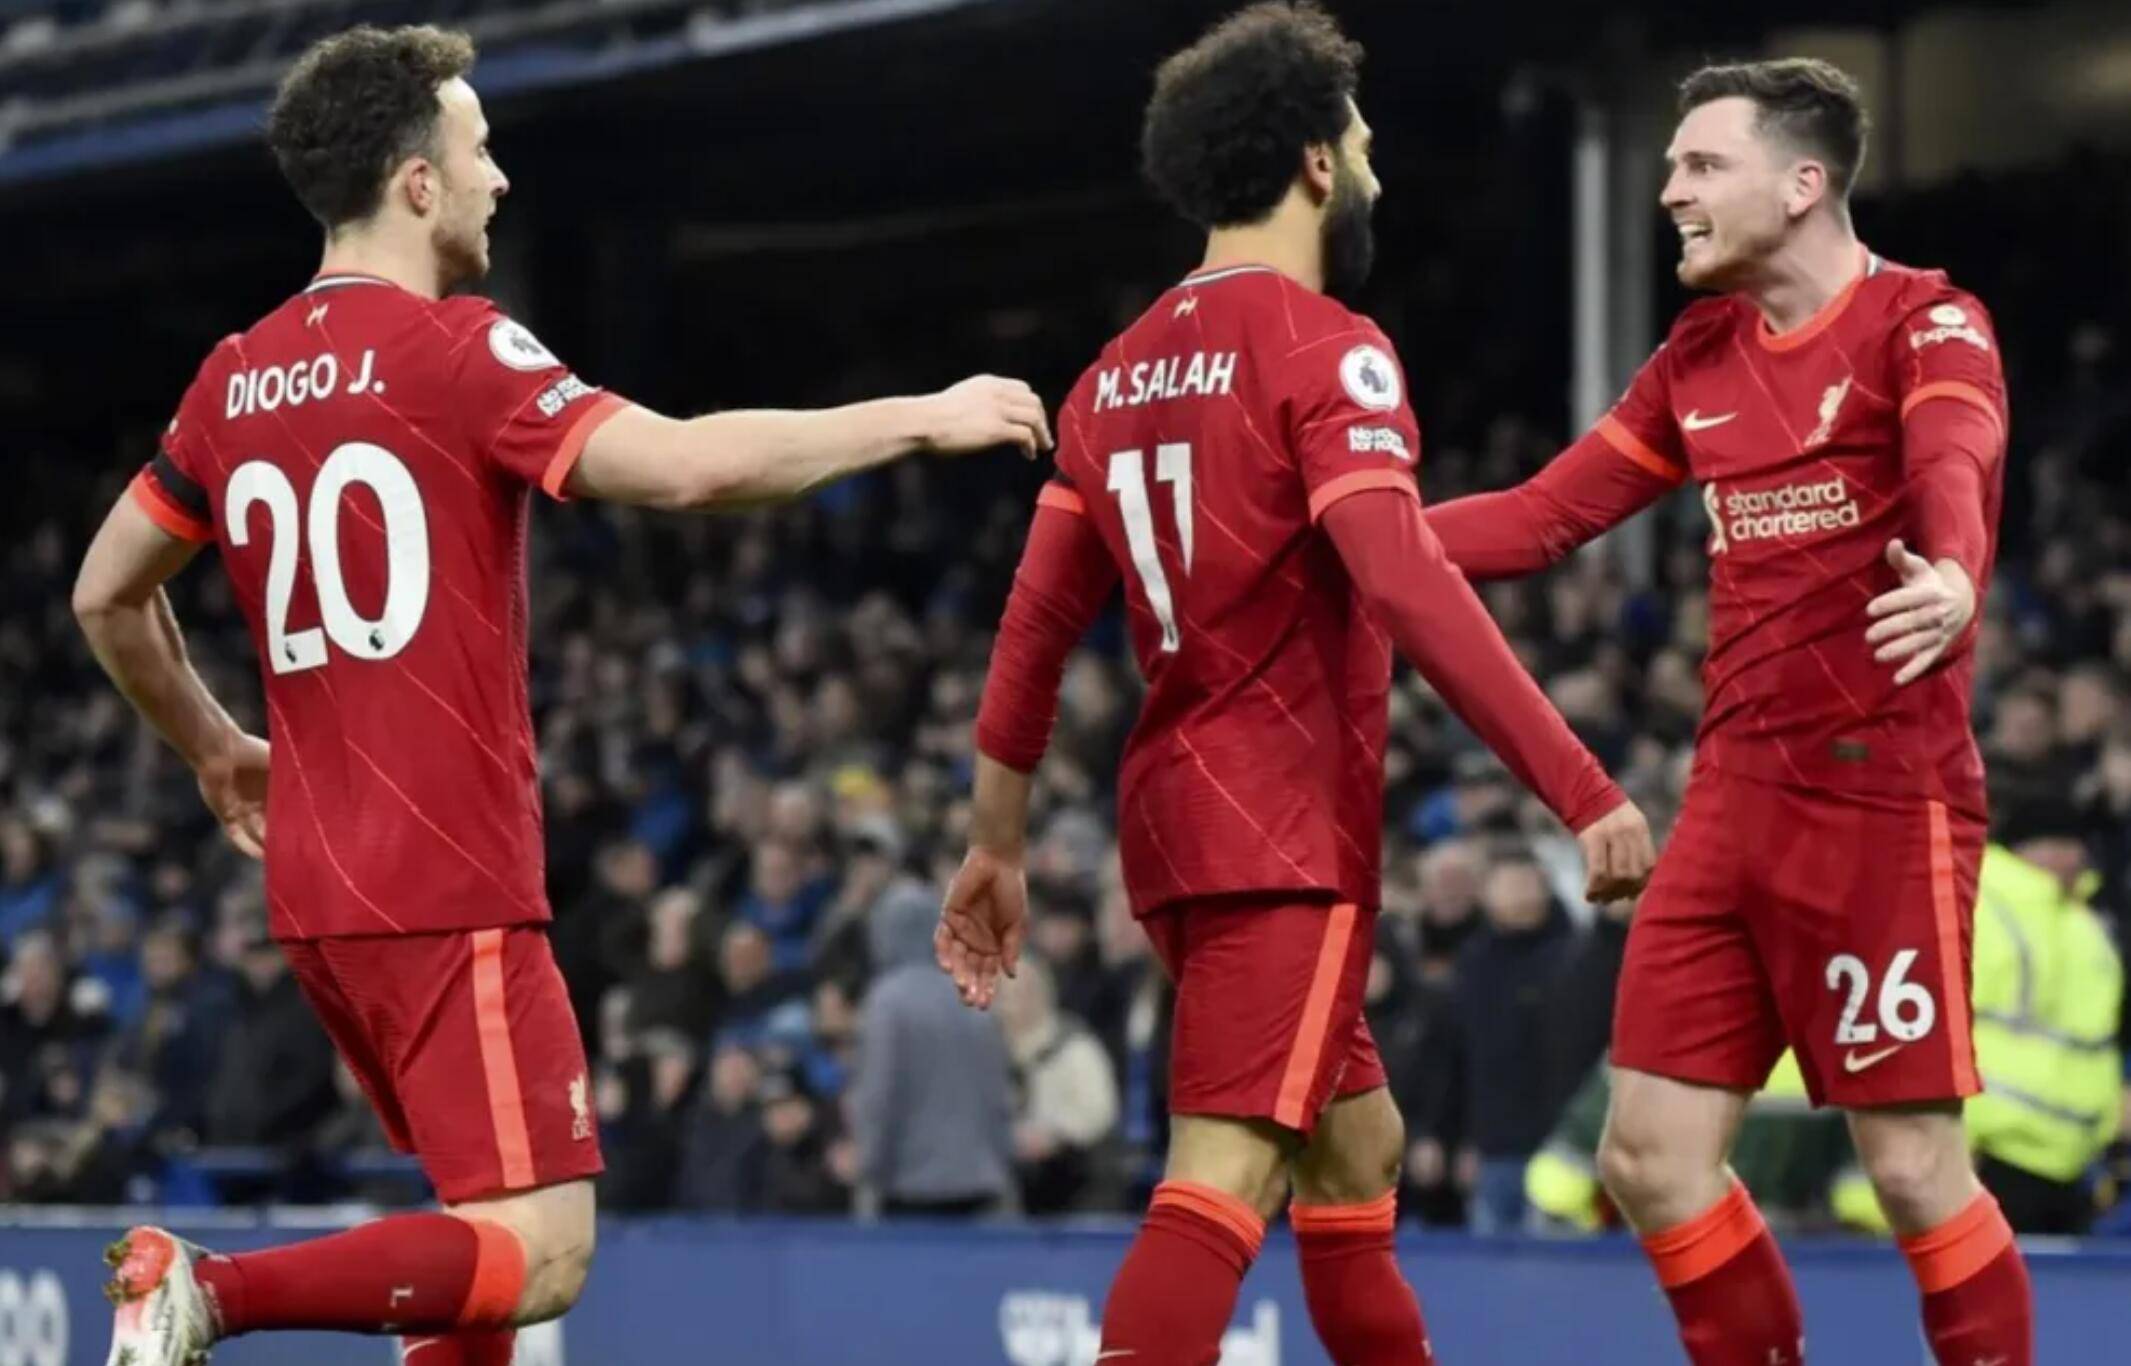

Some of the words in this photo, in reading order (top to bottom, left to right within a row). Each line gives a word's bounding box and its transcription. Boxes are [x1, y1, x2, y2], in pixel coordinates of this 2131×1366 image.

[225, 353, 337, 420] DIOGO
[346, 349, 386, 395] J.
[1726, 477, 1845, 515] standard
[1731, 500, 1860, 541] chartered
[225, 442, 430, 675] 20
[1107, 442, 1193, 653] 11
[1826, 949, 1935, 1044] 26
